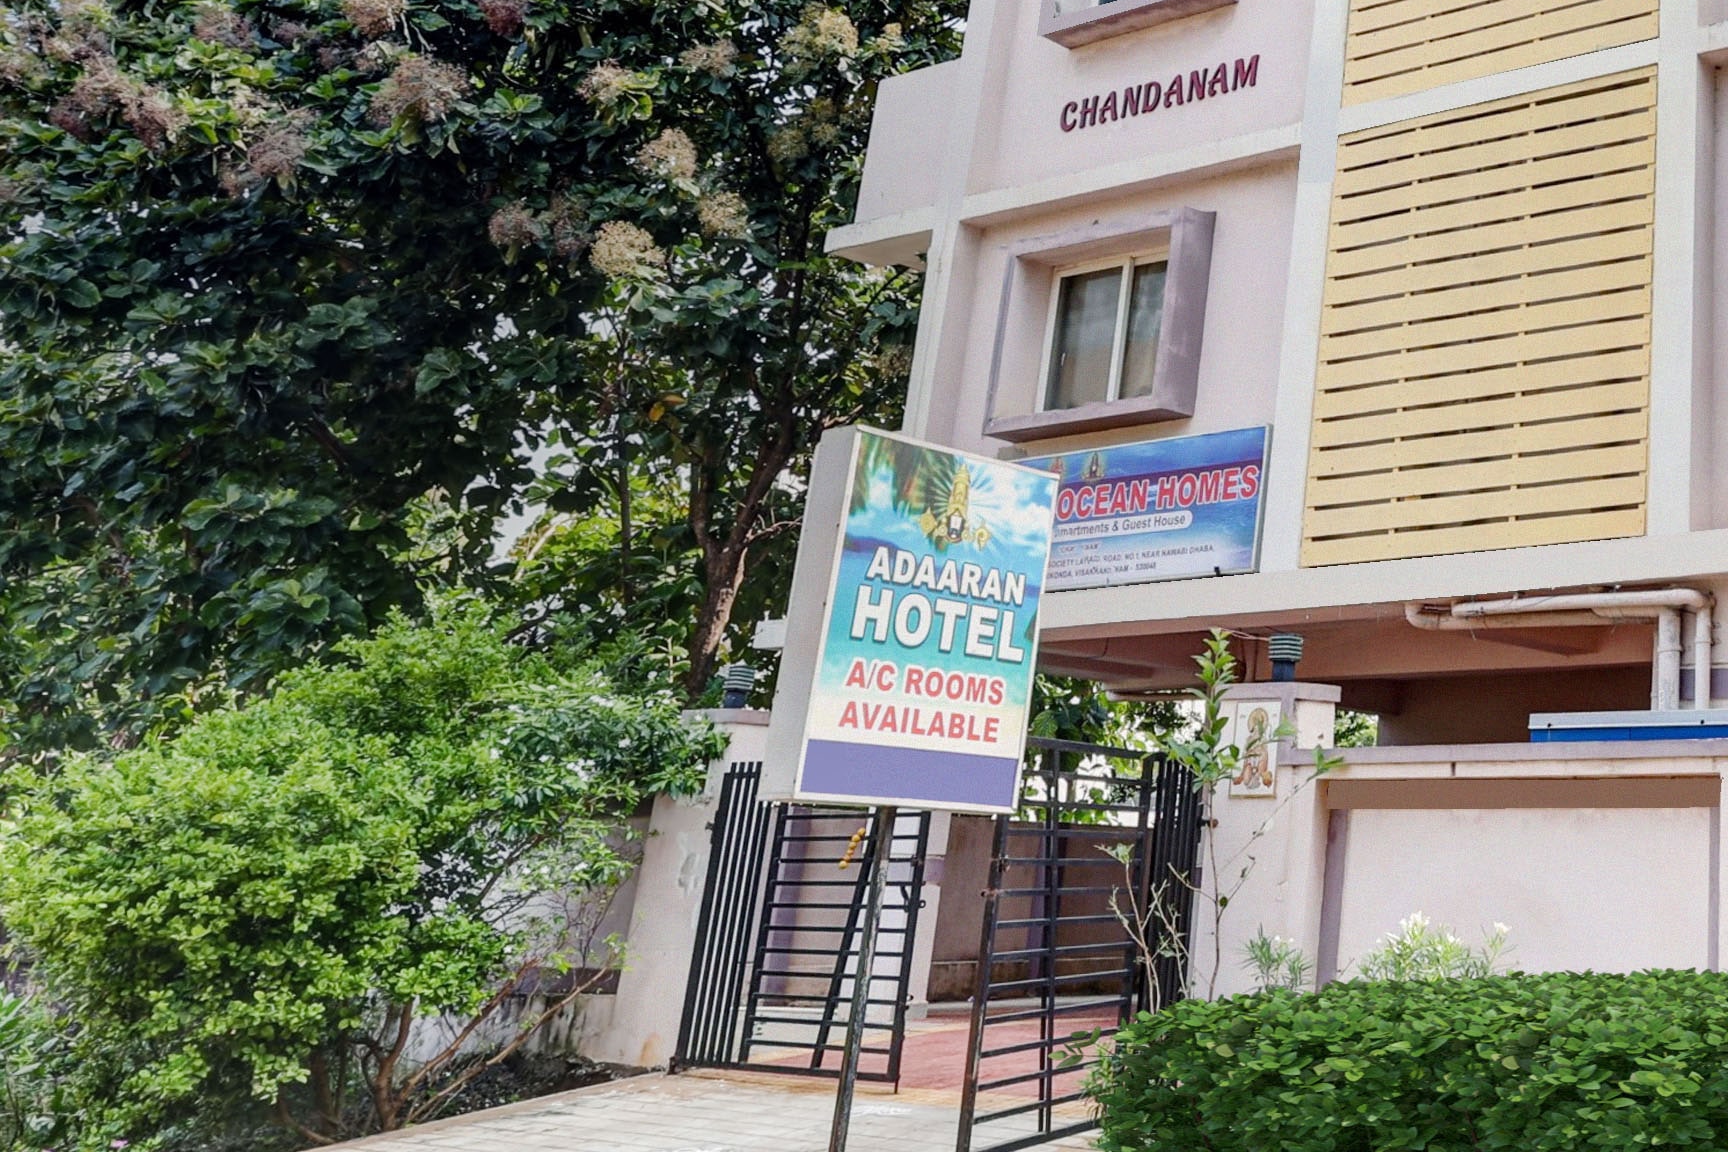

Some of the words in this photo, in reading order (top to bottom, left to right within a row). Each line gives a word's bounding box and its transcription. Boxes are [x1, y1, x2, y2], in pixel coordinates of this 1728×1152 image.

[1060, 54, 1260, 133] CHANDANAM
[1056, 479, 1150, 521] OCEAN
[1155, 465, 1260, 511] HOMES
[1111, 519, 1120, 532] &
[1122, 517, 1152, 532] Guest
[1154, 513, 1186, 528] House
[866, 546, 1027, 606] ADAARAN
[849, 584, 1026, 664] HOTEL
[845, 659, 896, 692] A/C
[904, 667, 1006, 706] ROOMS
[838, 700, 1001, 744] AVAILABLE
